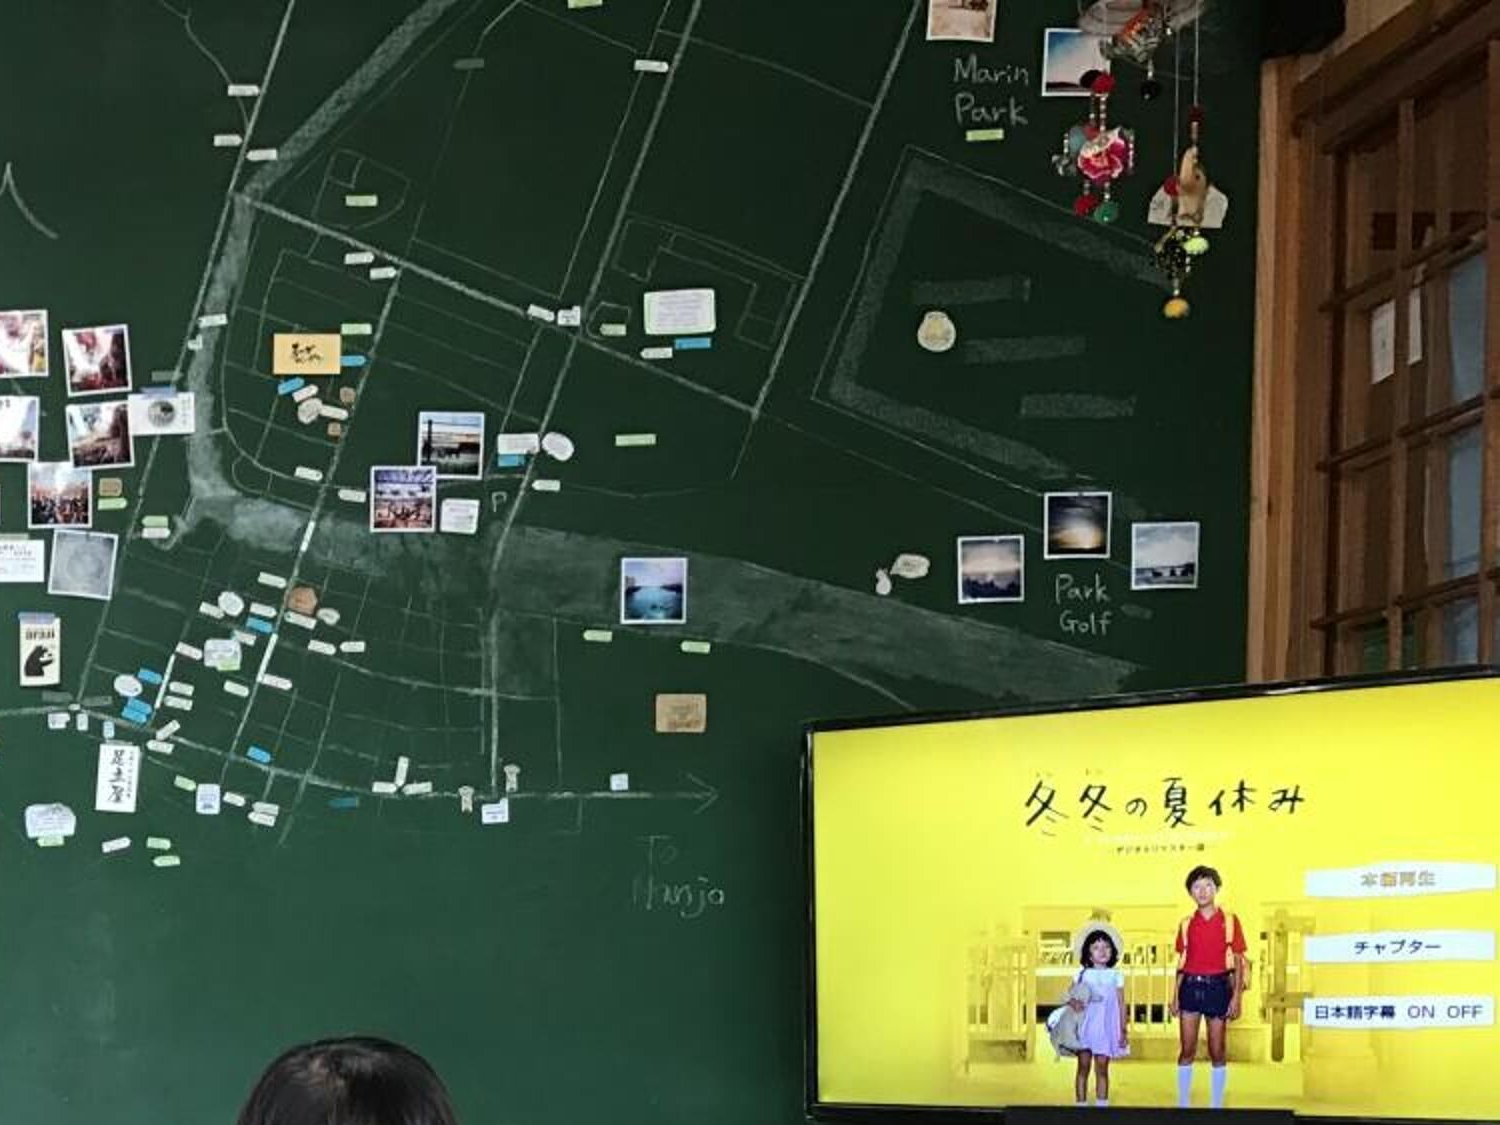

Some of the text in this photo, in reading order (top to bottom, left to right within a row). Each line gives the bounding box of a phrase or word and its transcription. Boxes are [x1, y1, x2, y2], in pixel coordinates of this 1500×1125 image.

[953, 53, 1029, 85] Marin
[955, 92, 1029, 126] Park
[1055, 571, 1112, 605] Park
[1059, 609, 1113, 636] Golf
[1023, 776, 1306, 838] 冬冬の夏休み
[1354, 939, 1442, 955] チャプター
[1314, 1004, 1484, 1021] 日本語字幕 ON OFF
